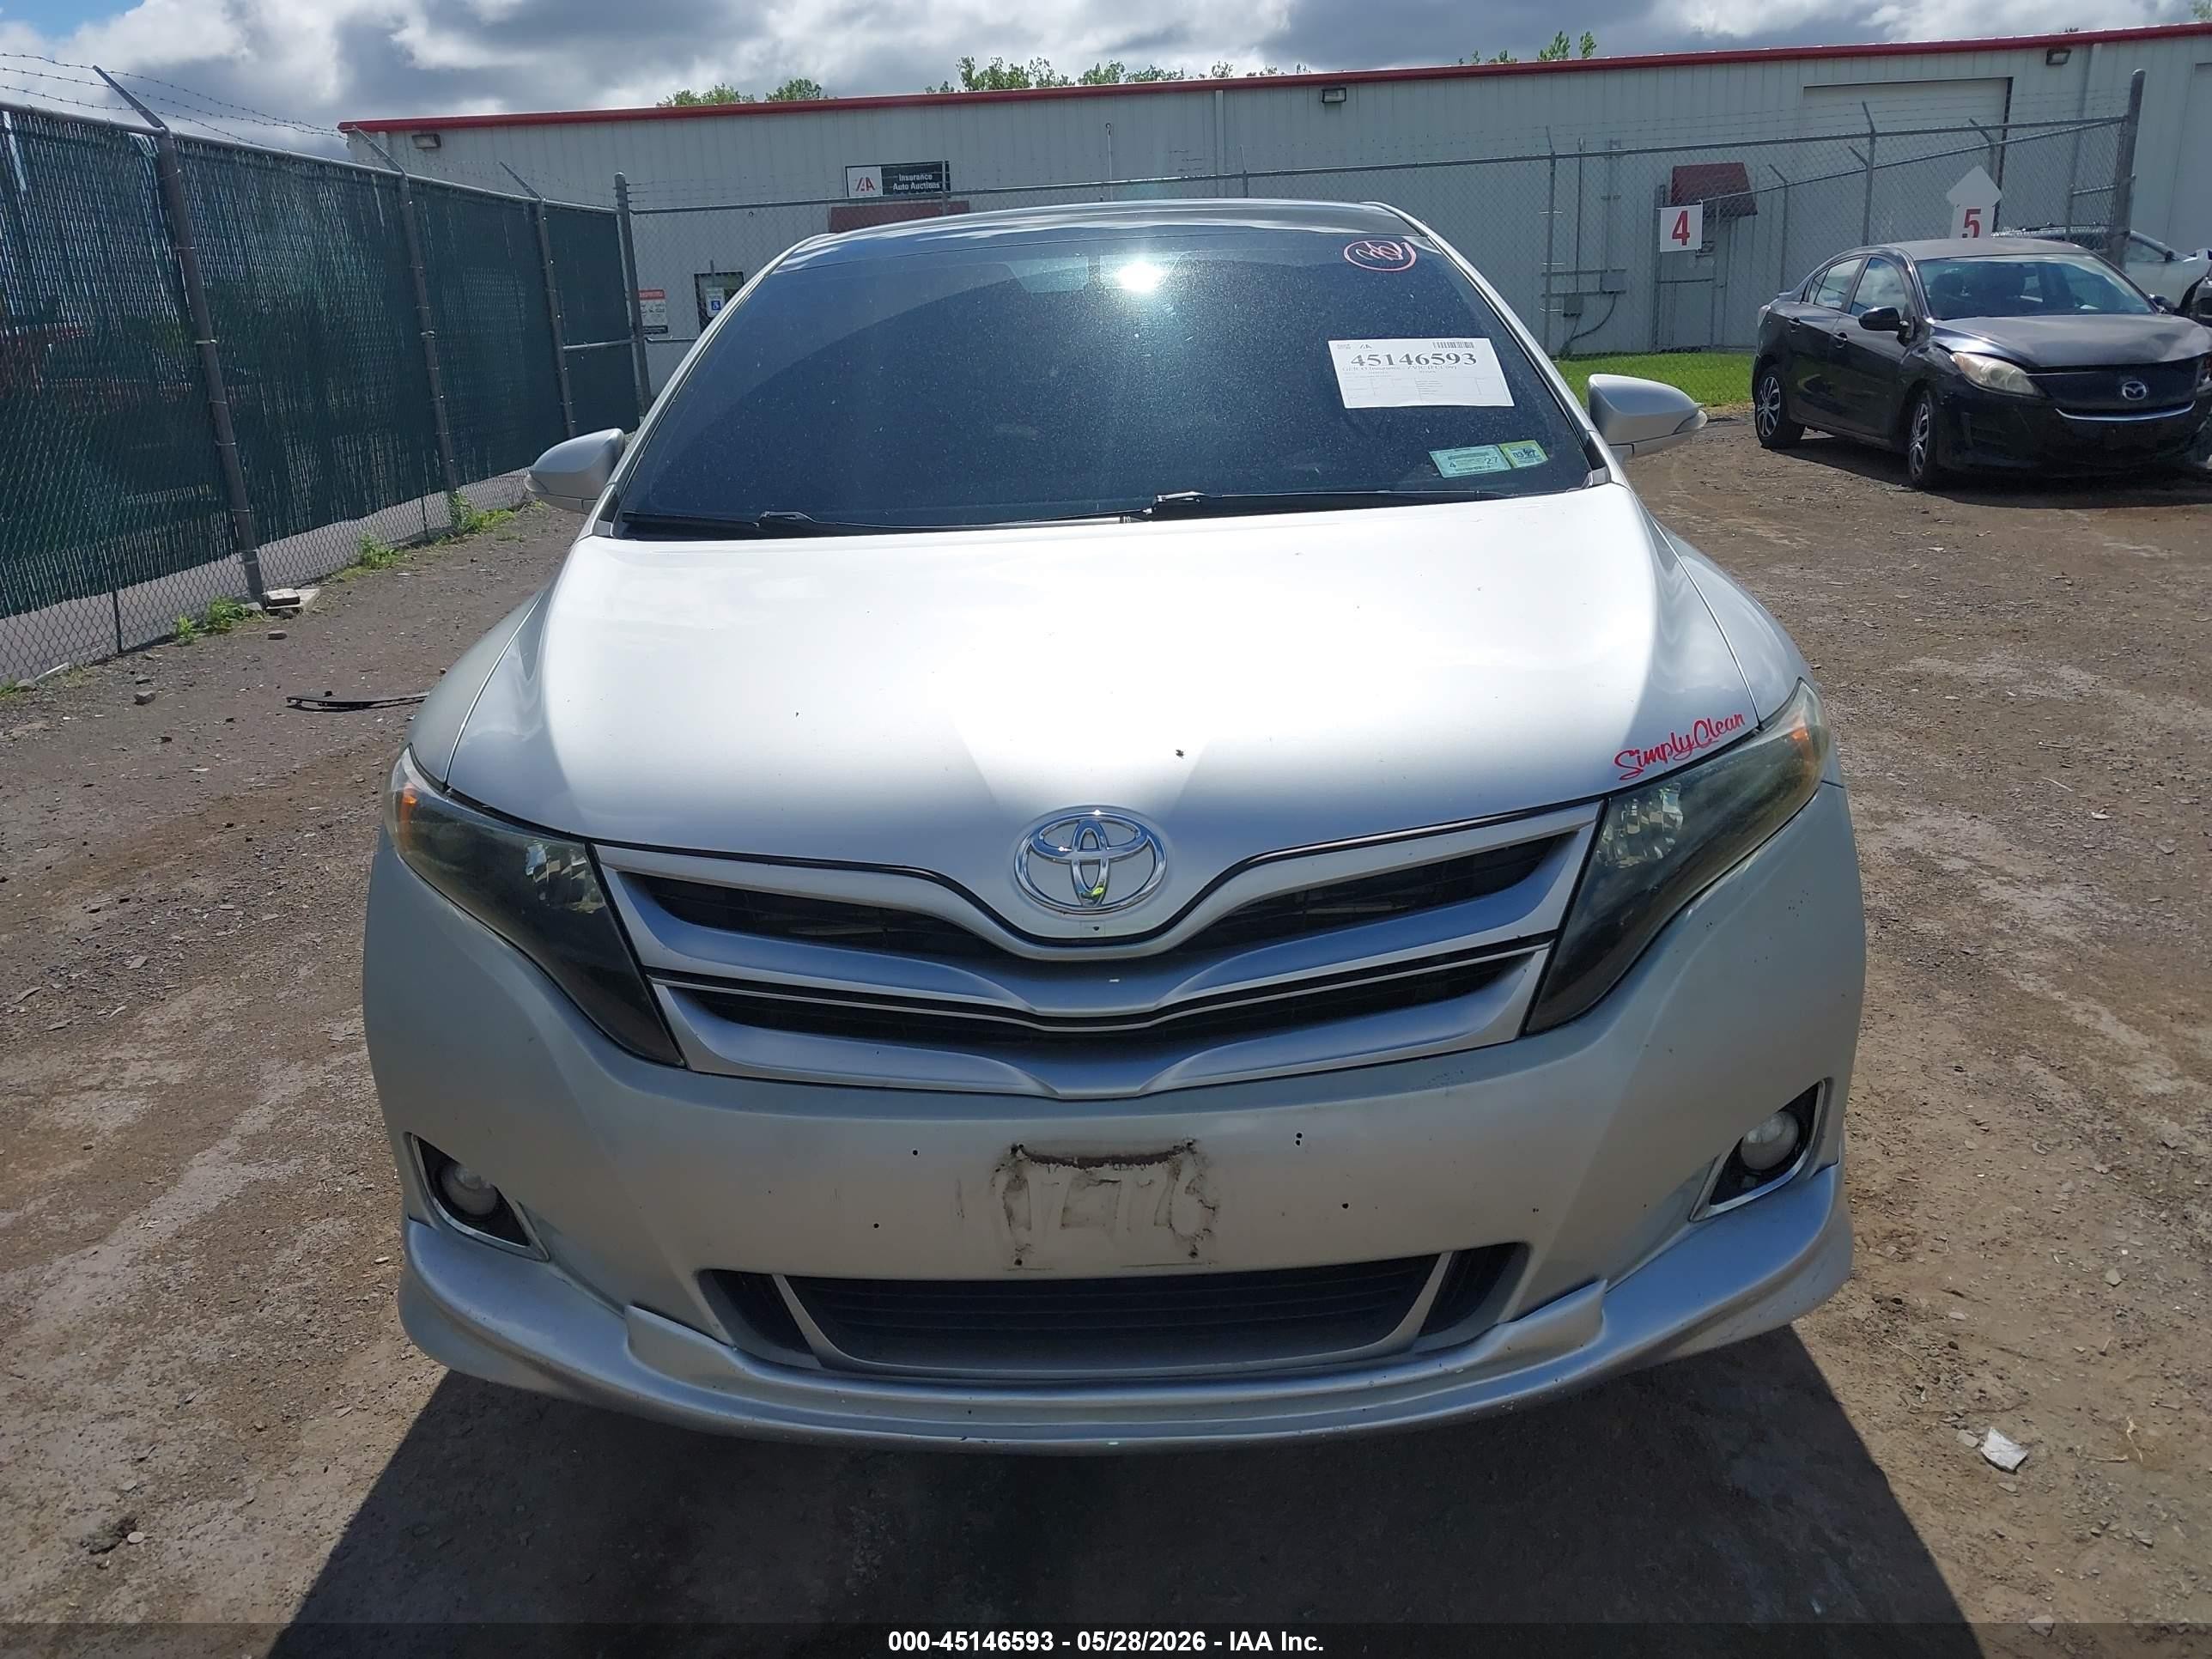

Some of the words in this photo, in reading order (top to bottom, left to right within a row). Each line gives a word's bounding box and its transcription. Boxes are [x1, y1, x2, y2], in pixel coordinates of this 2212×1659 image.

[1672, 210, 1690, 246] 4
[1961, 209, 1981, 239] 5
[1351, 352, 1477, 366] 45146593
